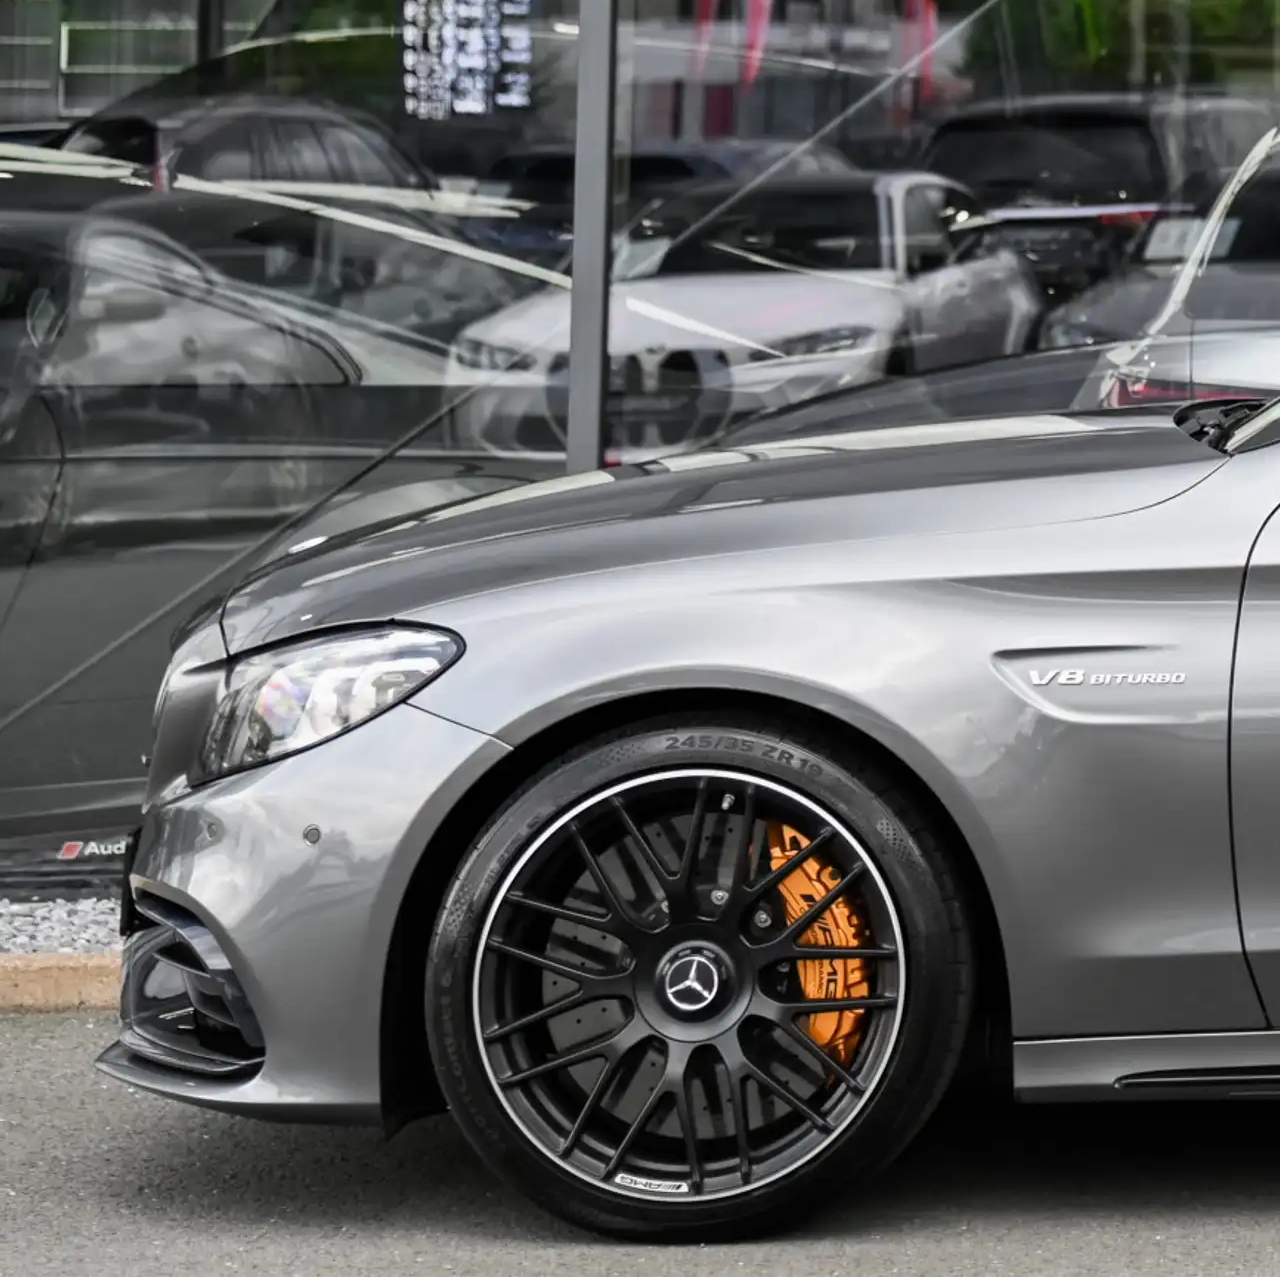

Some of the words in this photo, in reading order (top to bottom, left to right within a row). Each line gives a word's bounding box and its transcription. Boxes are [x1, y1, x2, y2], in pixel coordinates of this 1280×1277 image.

[1028, 669, 1085, 686] V8
[1090, 673, 1187, 686] BITURBO
[665, 735, 754, 753] 245/35
